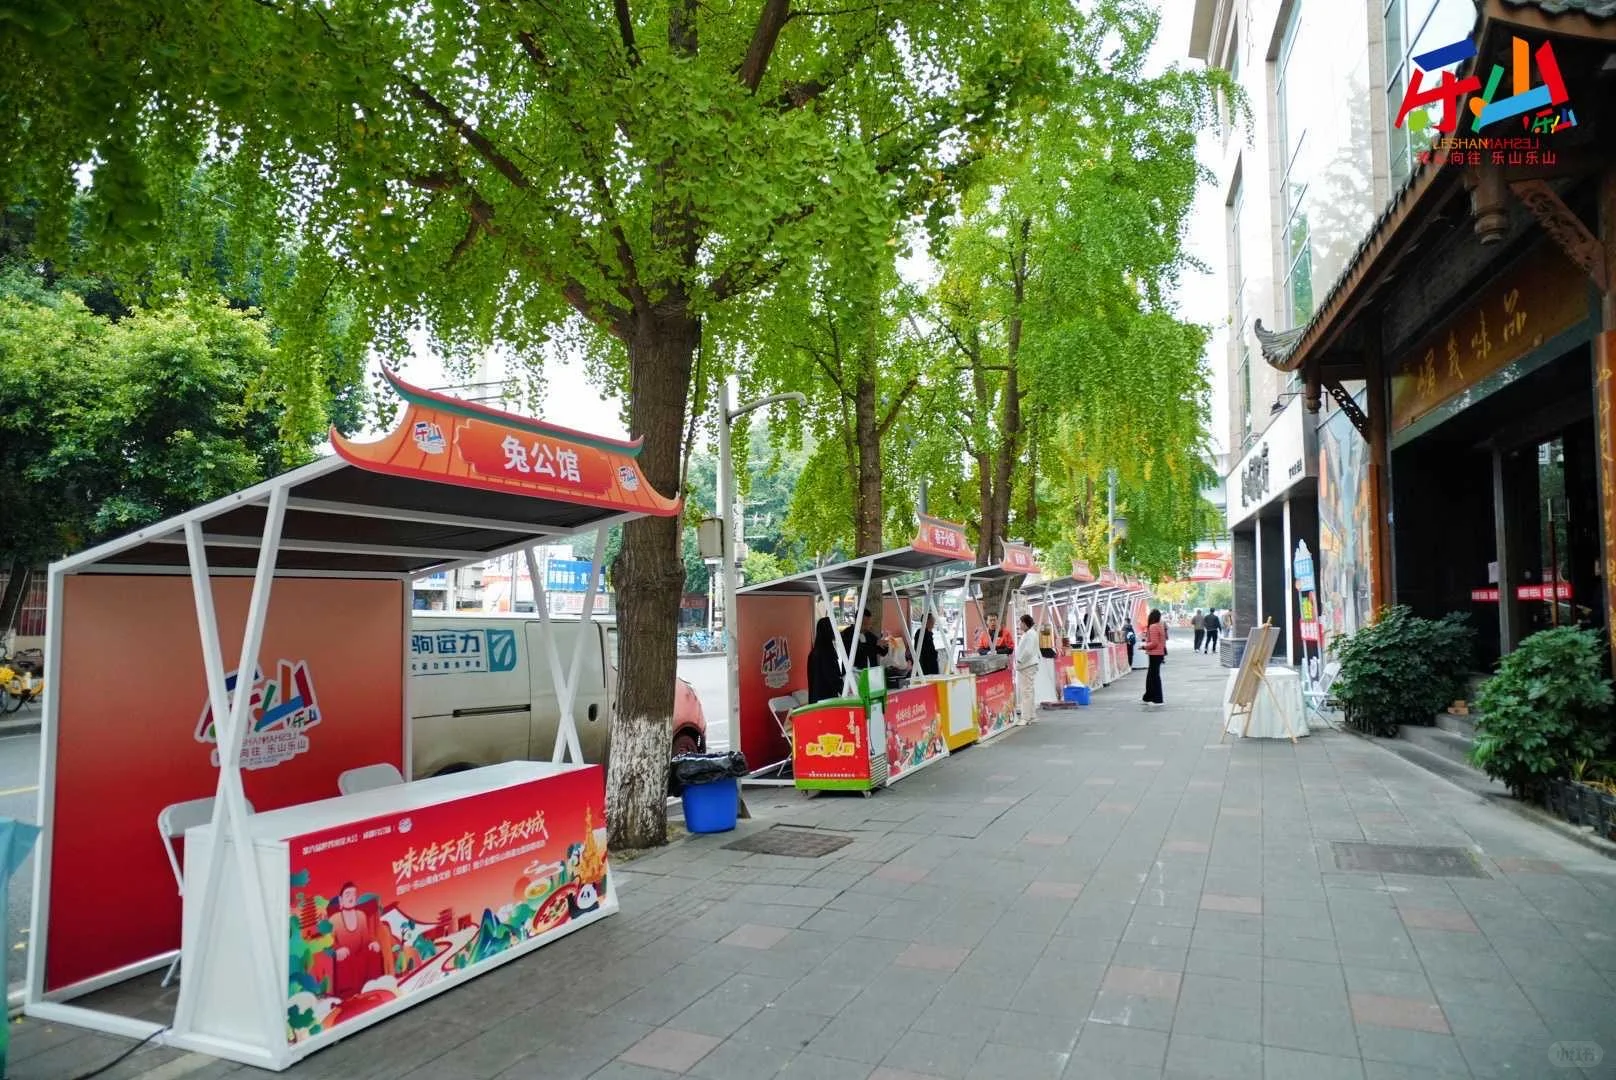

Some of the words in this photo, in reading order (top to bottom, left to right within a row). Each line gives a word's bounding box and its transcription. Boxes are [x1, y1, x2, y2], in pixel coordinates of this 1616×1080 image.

[501, 434, 581, 483] 兔公馆
[392, 832, 475, 885] 味传天府
[478, 810, 549, 857] 乐享双城
